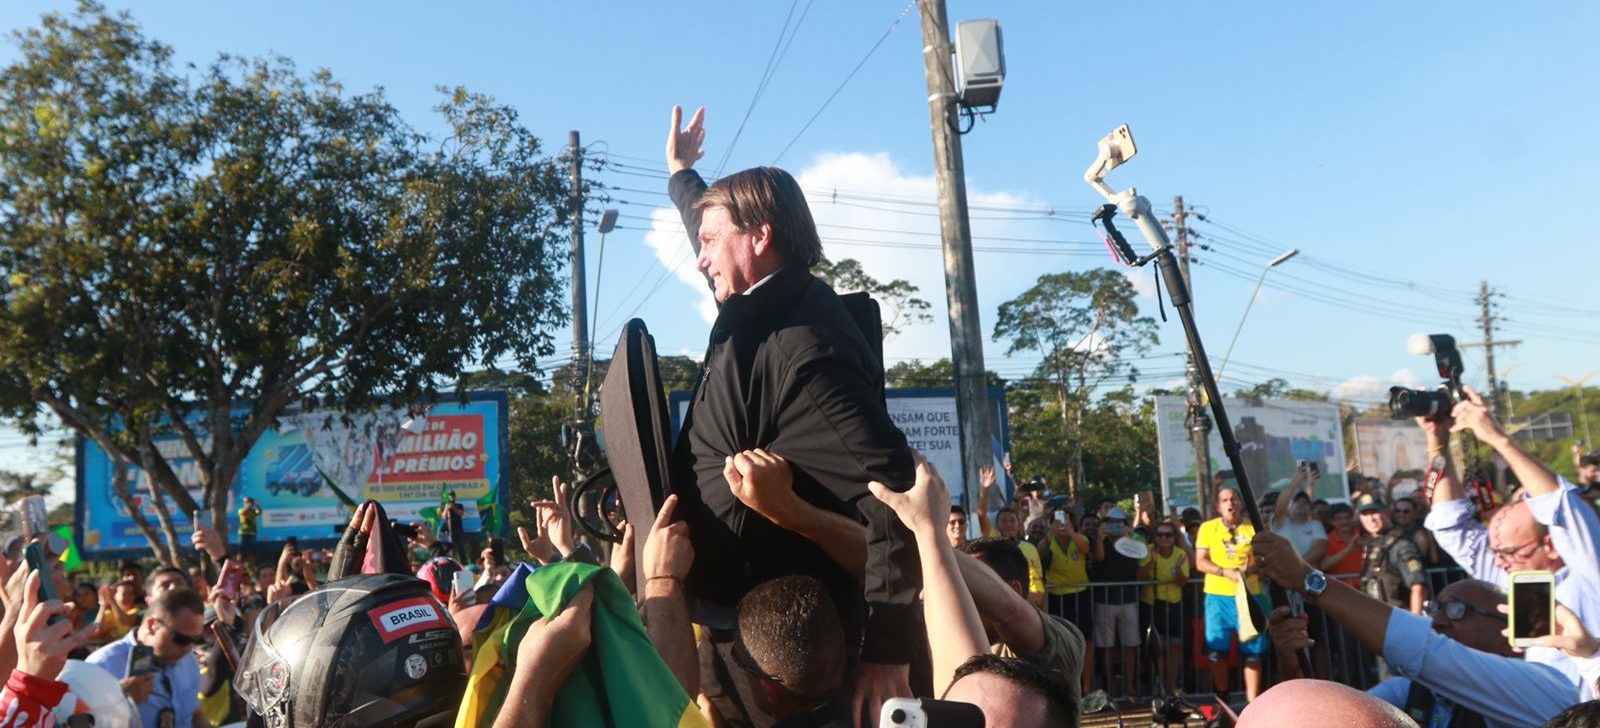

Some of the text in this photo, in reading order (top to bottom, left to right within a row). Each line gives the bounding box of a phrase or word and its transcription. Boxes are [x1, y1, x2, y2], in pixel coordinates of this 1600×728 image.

[892, 412, 950, 423] NSAM QUE
[431, 421, 447, 431] DE
[904, 426, 960, 437] AM FORTE
[396, 429, 478, 453] MILHÃO
[908, 440, 952, 451] TE! SUA
[393, 454, 476, 474] PRÊMIOS
[390, 609, 431, 626] BRASIL
